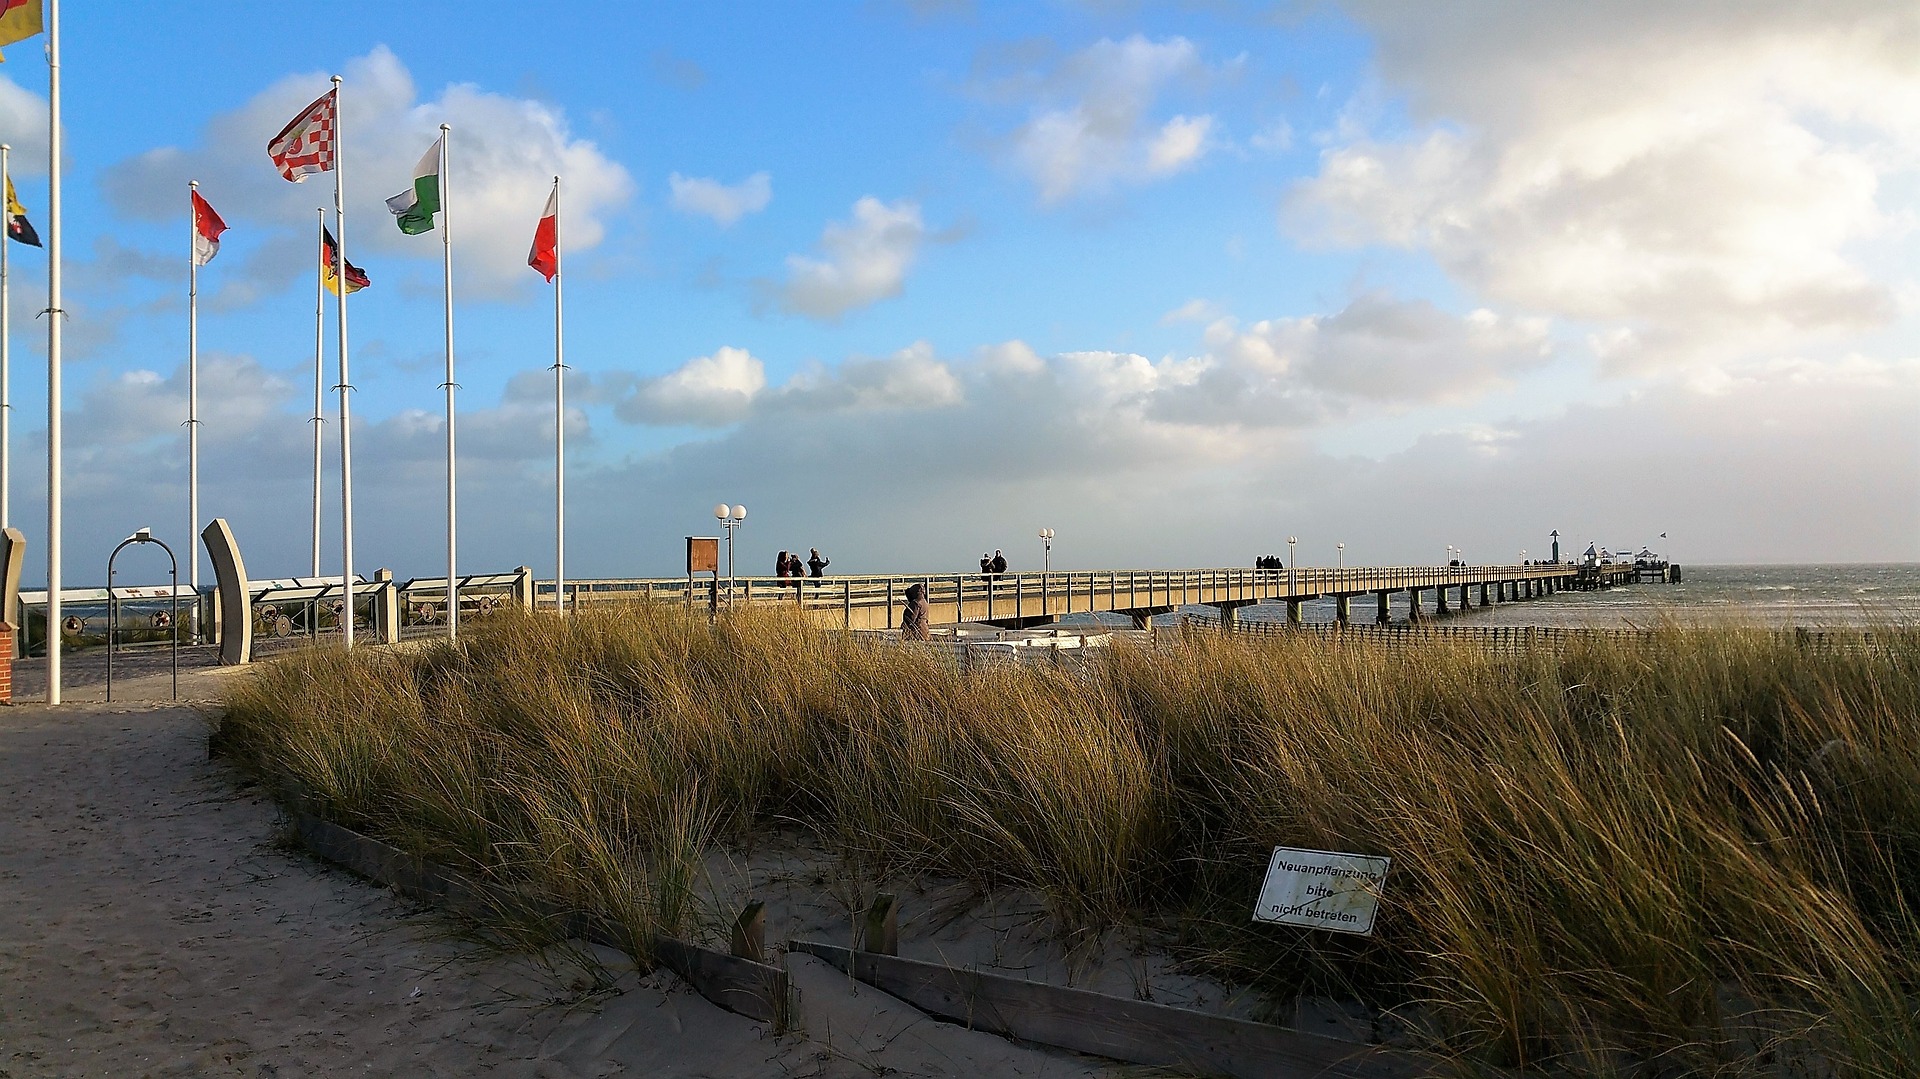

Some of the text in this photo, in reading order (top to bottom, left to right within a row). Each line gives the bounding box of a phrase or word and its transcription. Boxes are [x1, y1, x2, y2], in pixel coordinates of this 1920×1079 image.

[1278, 861, 1377, 881] Neuanpflanzung
[1306, 885, 1334, 898] bitte
[1272, 904, 1357, 923] nicht betreten
